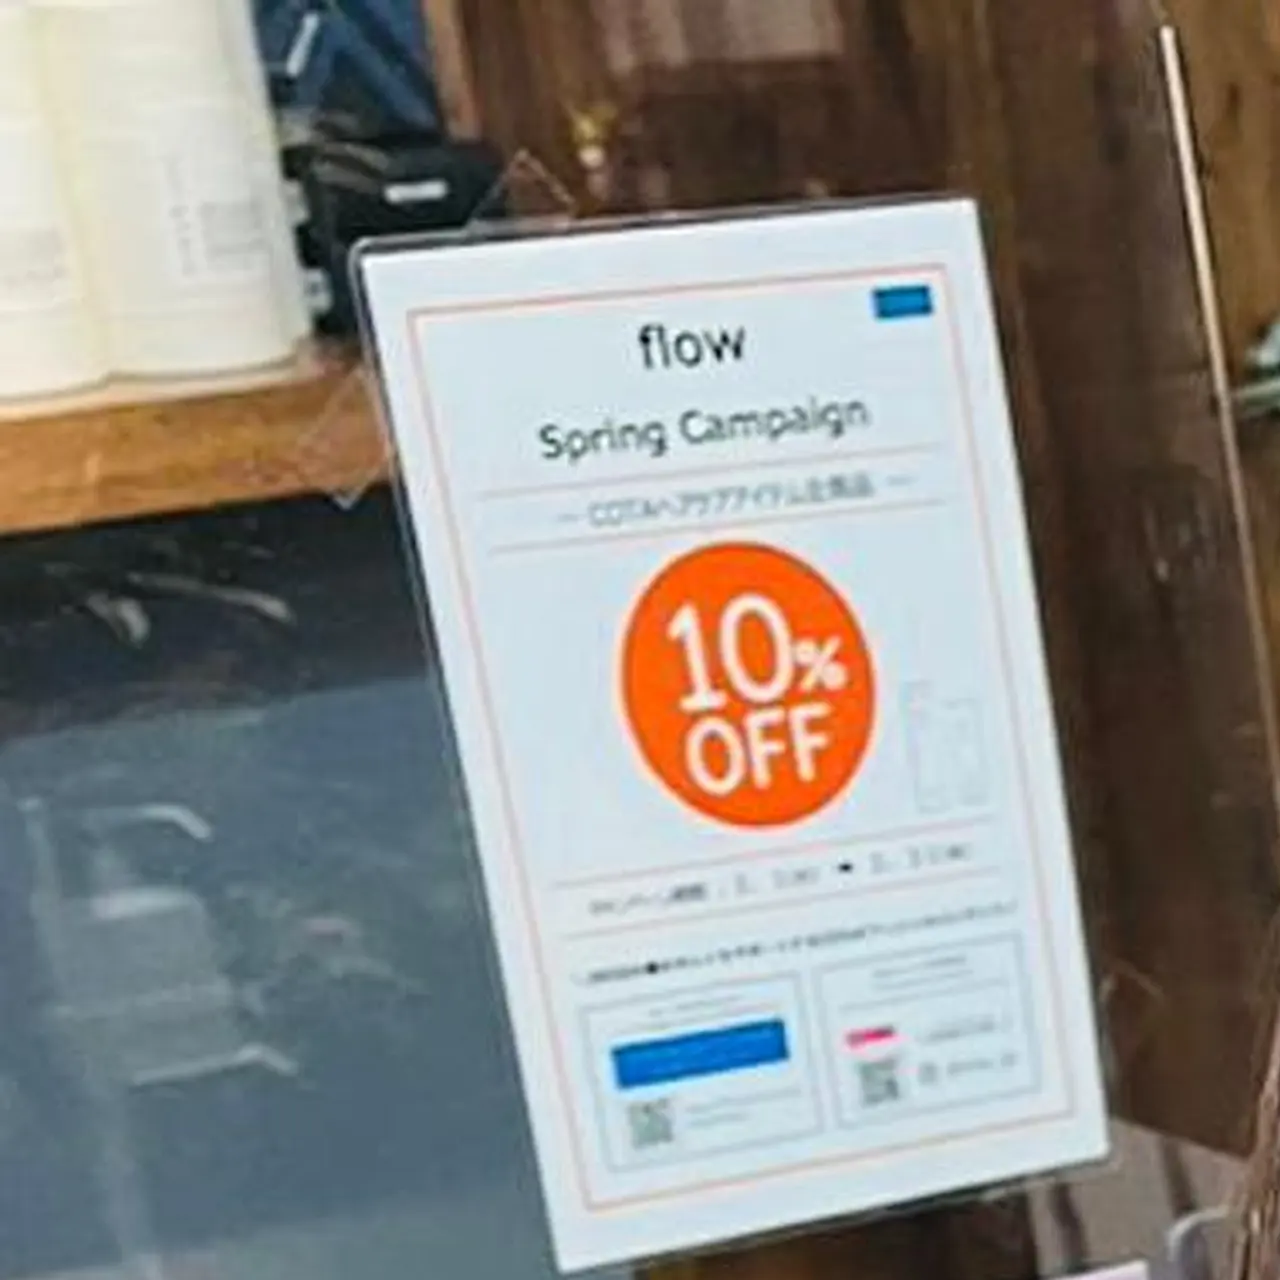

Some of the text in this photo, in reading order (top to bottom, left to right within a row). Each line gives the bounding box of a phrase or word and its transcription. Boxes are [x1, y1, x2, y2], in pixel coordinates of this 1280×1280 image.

[638, 322, 746, 370] flow
[537, 395, 873, 466] Spring Campaign
[666, 592, 849, 712] 10%
[684, 701, 834, 796] OFF
